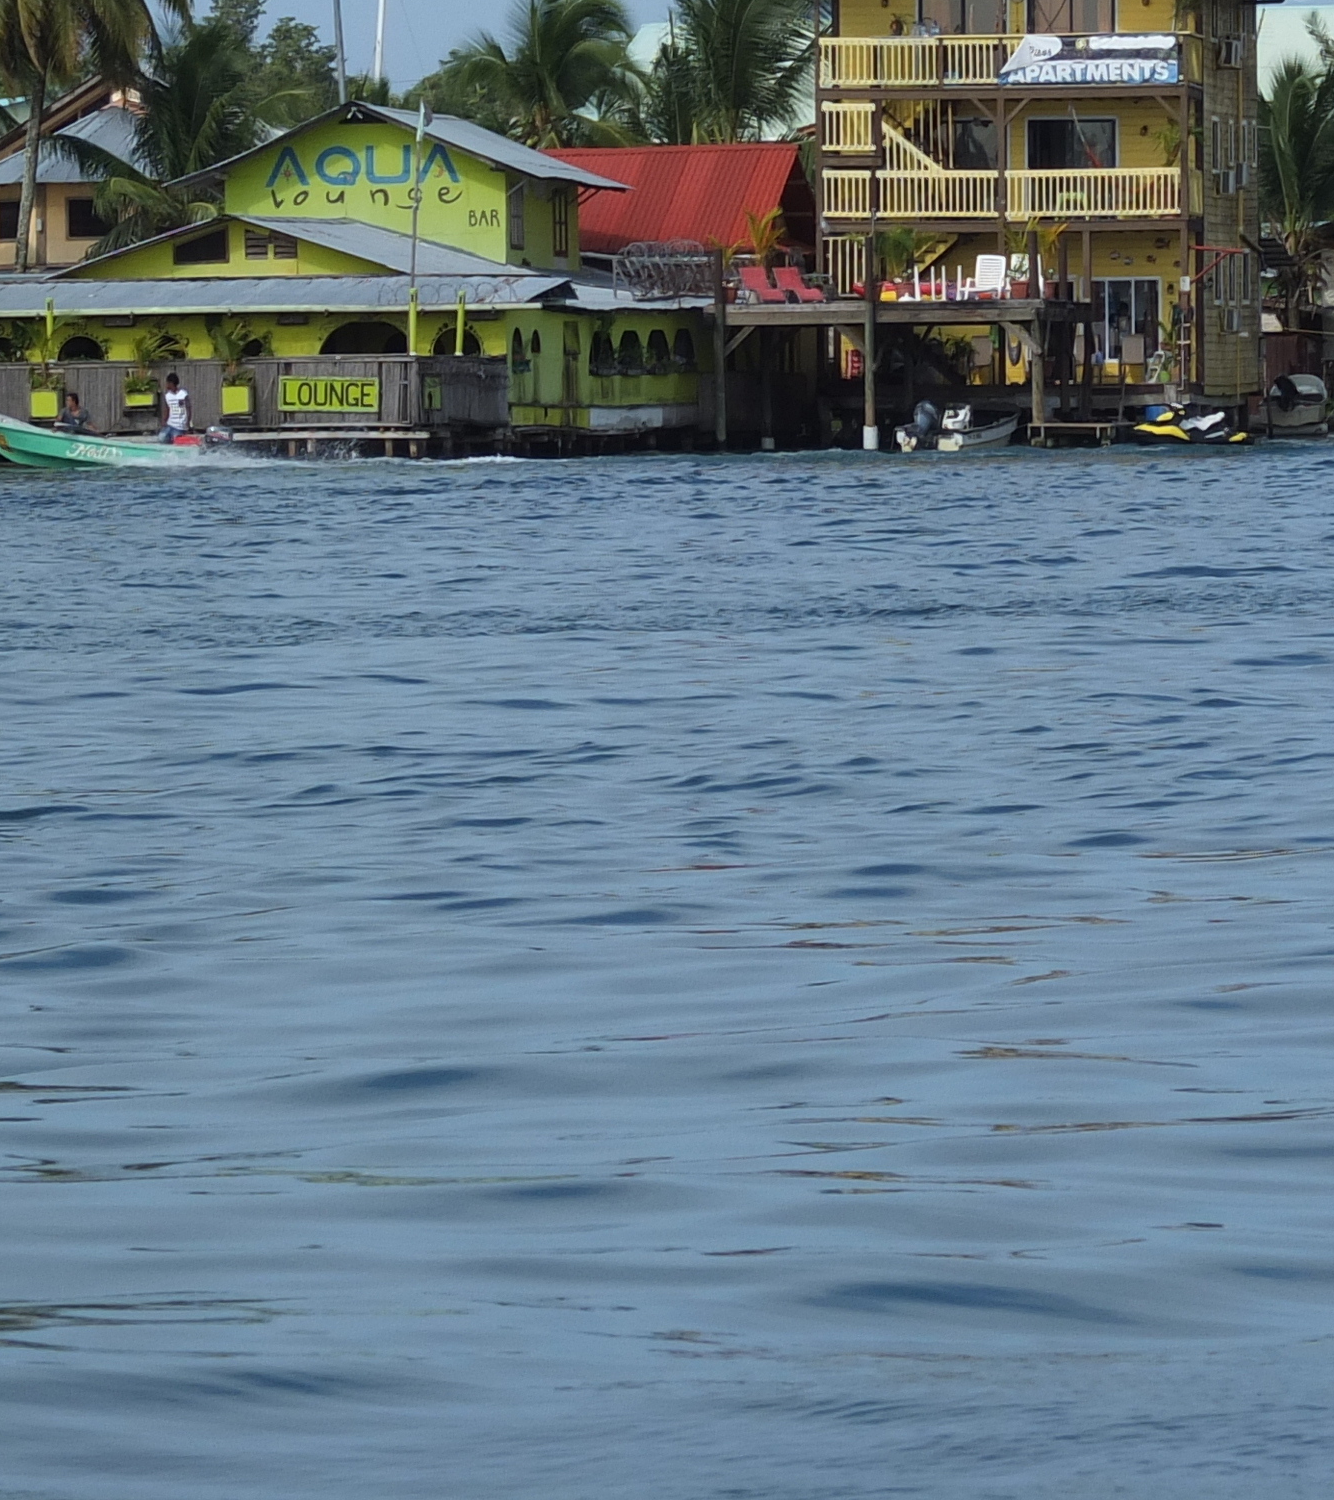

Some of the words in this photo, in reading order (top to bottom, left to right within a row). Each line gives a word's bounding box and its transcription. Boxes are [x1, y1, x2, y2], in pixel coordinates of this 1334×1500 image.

[265, 143, 460, 187] AQUA
[468, 209, 501, 227] BAR
[283, 382, 375, 408] LOUNGE
